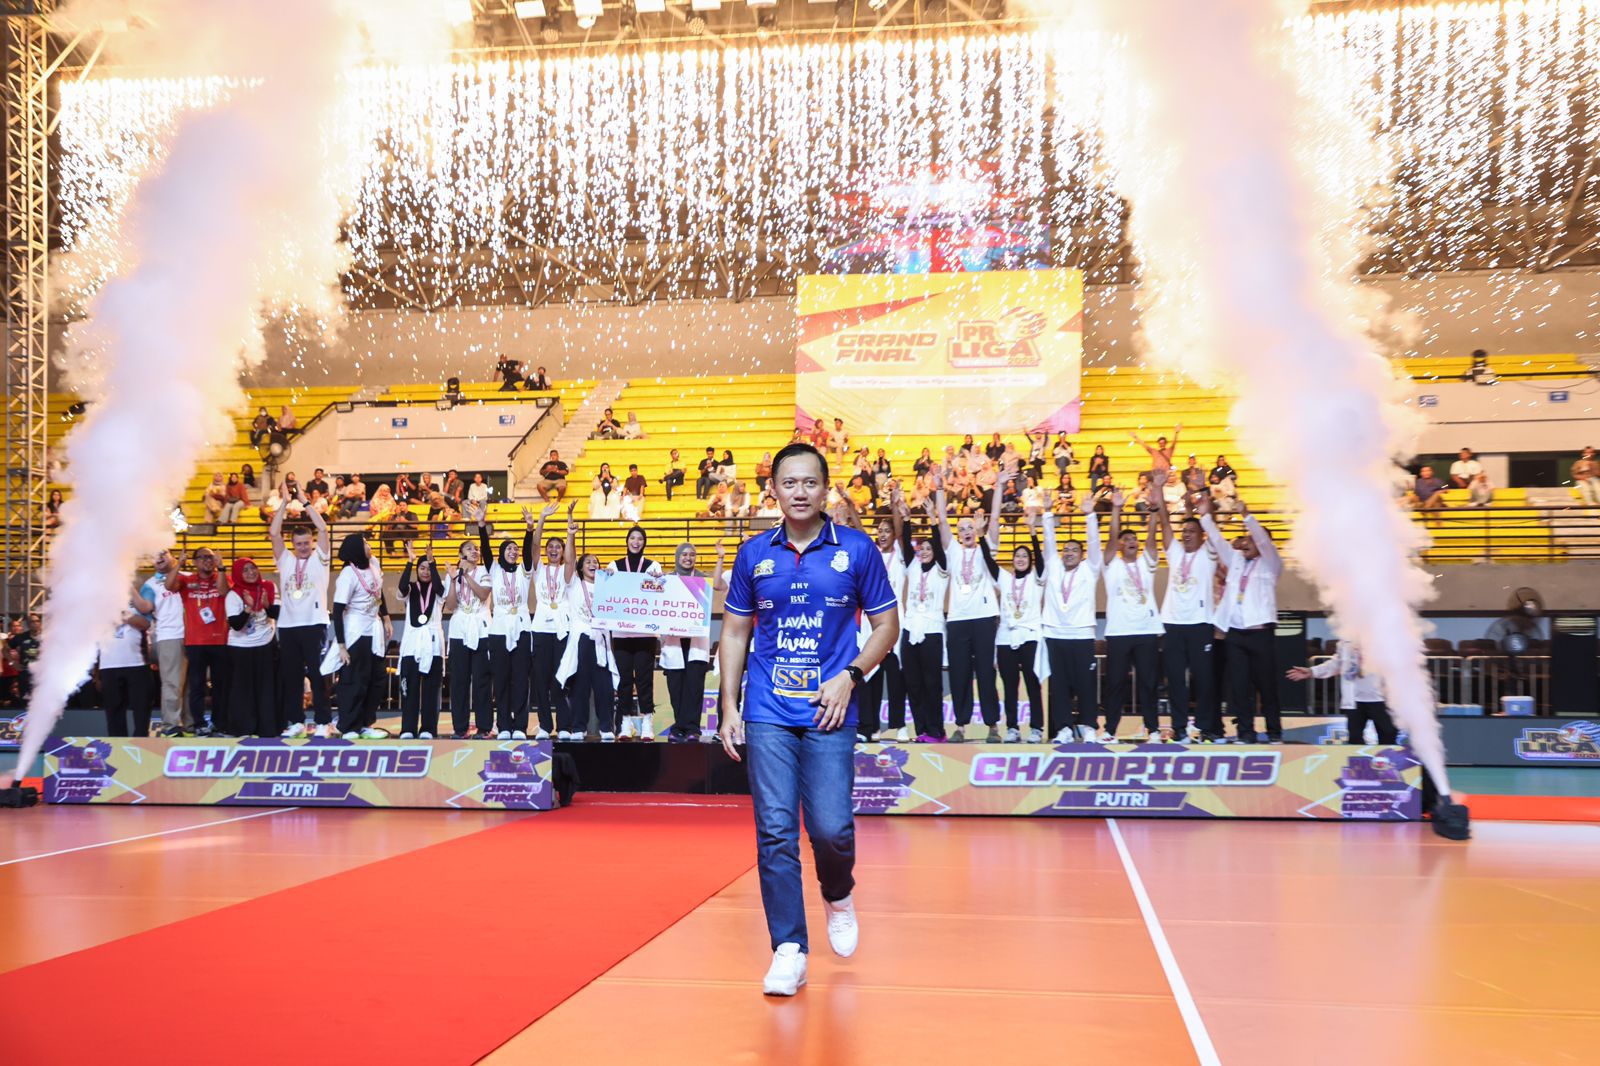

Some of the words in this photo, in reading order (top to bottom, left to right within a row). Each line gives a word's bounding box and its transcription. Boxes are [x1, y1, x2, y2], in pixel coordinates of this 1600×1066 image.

[836, 332, 938, 347] GRAND
[835, 349, 916, 362] FINAL
[952, 340, 1033, 357] LIGA
[791, 582, 809, 590] AHY
[605, 597, 649, 606] JUARA
[663, 600, 699, 609] PUTRI
[597, 605, 617, 613] RP.
[623, 607, 706, 620] 400.000.000
[777, 612, 823, 630] LAVANI
[775, 656, 820, 664] TRNSMEDIA
[776, 668, 817, 689] SSP
[1522, 742, 1597, 753] LIGA
[169, 748, 428, 776] CHAMPIONS
[975, 753, 1277, 785] CHAMPIONS
[271, 782, 318, 797] PUTRI
[1094, 792, 1148, 807] PUTRI
